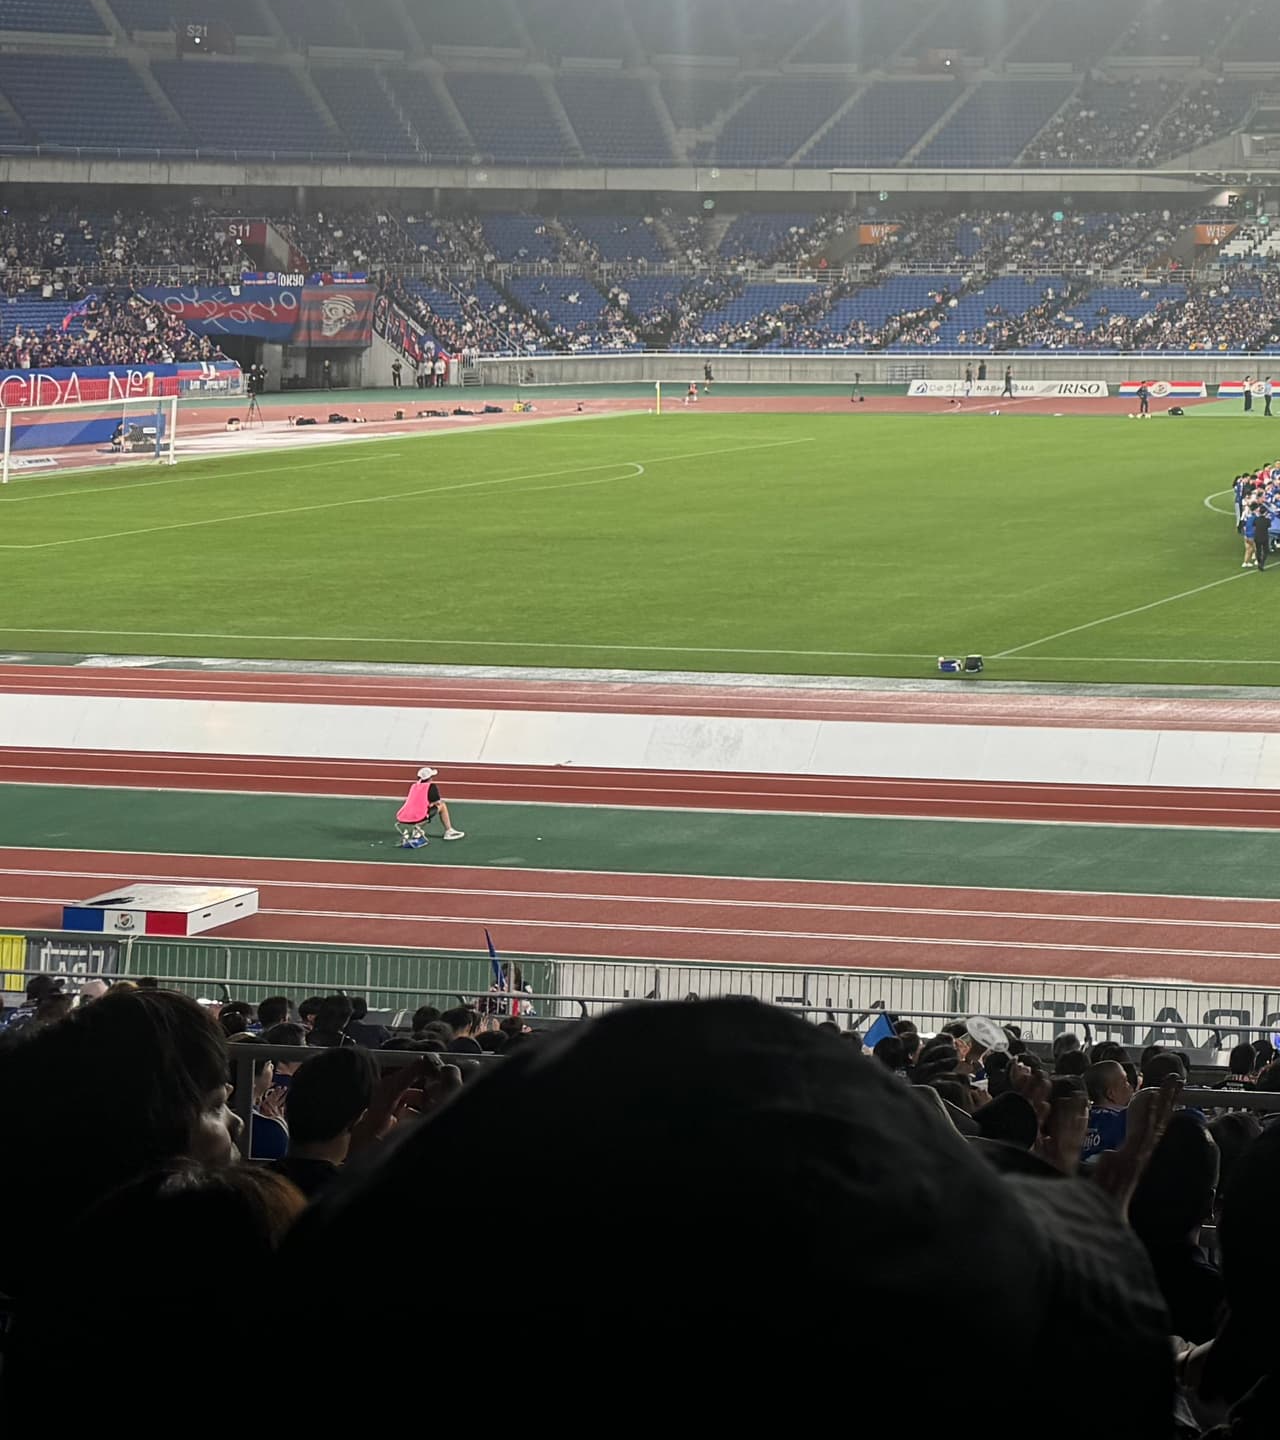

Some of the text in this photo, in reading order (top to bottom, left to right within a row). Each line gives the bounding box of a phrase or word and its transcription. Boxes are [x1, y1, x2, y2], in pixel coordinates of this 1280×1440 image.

[186, 24, 208, 38] S21
[228, 224, 250, 237] S11
[1206, 225, 1226, 237] W15
[202, 291, 297, 333] TOKYO
[1057, 382, 1100, 395] IRISO
